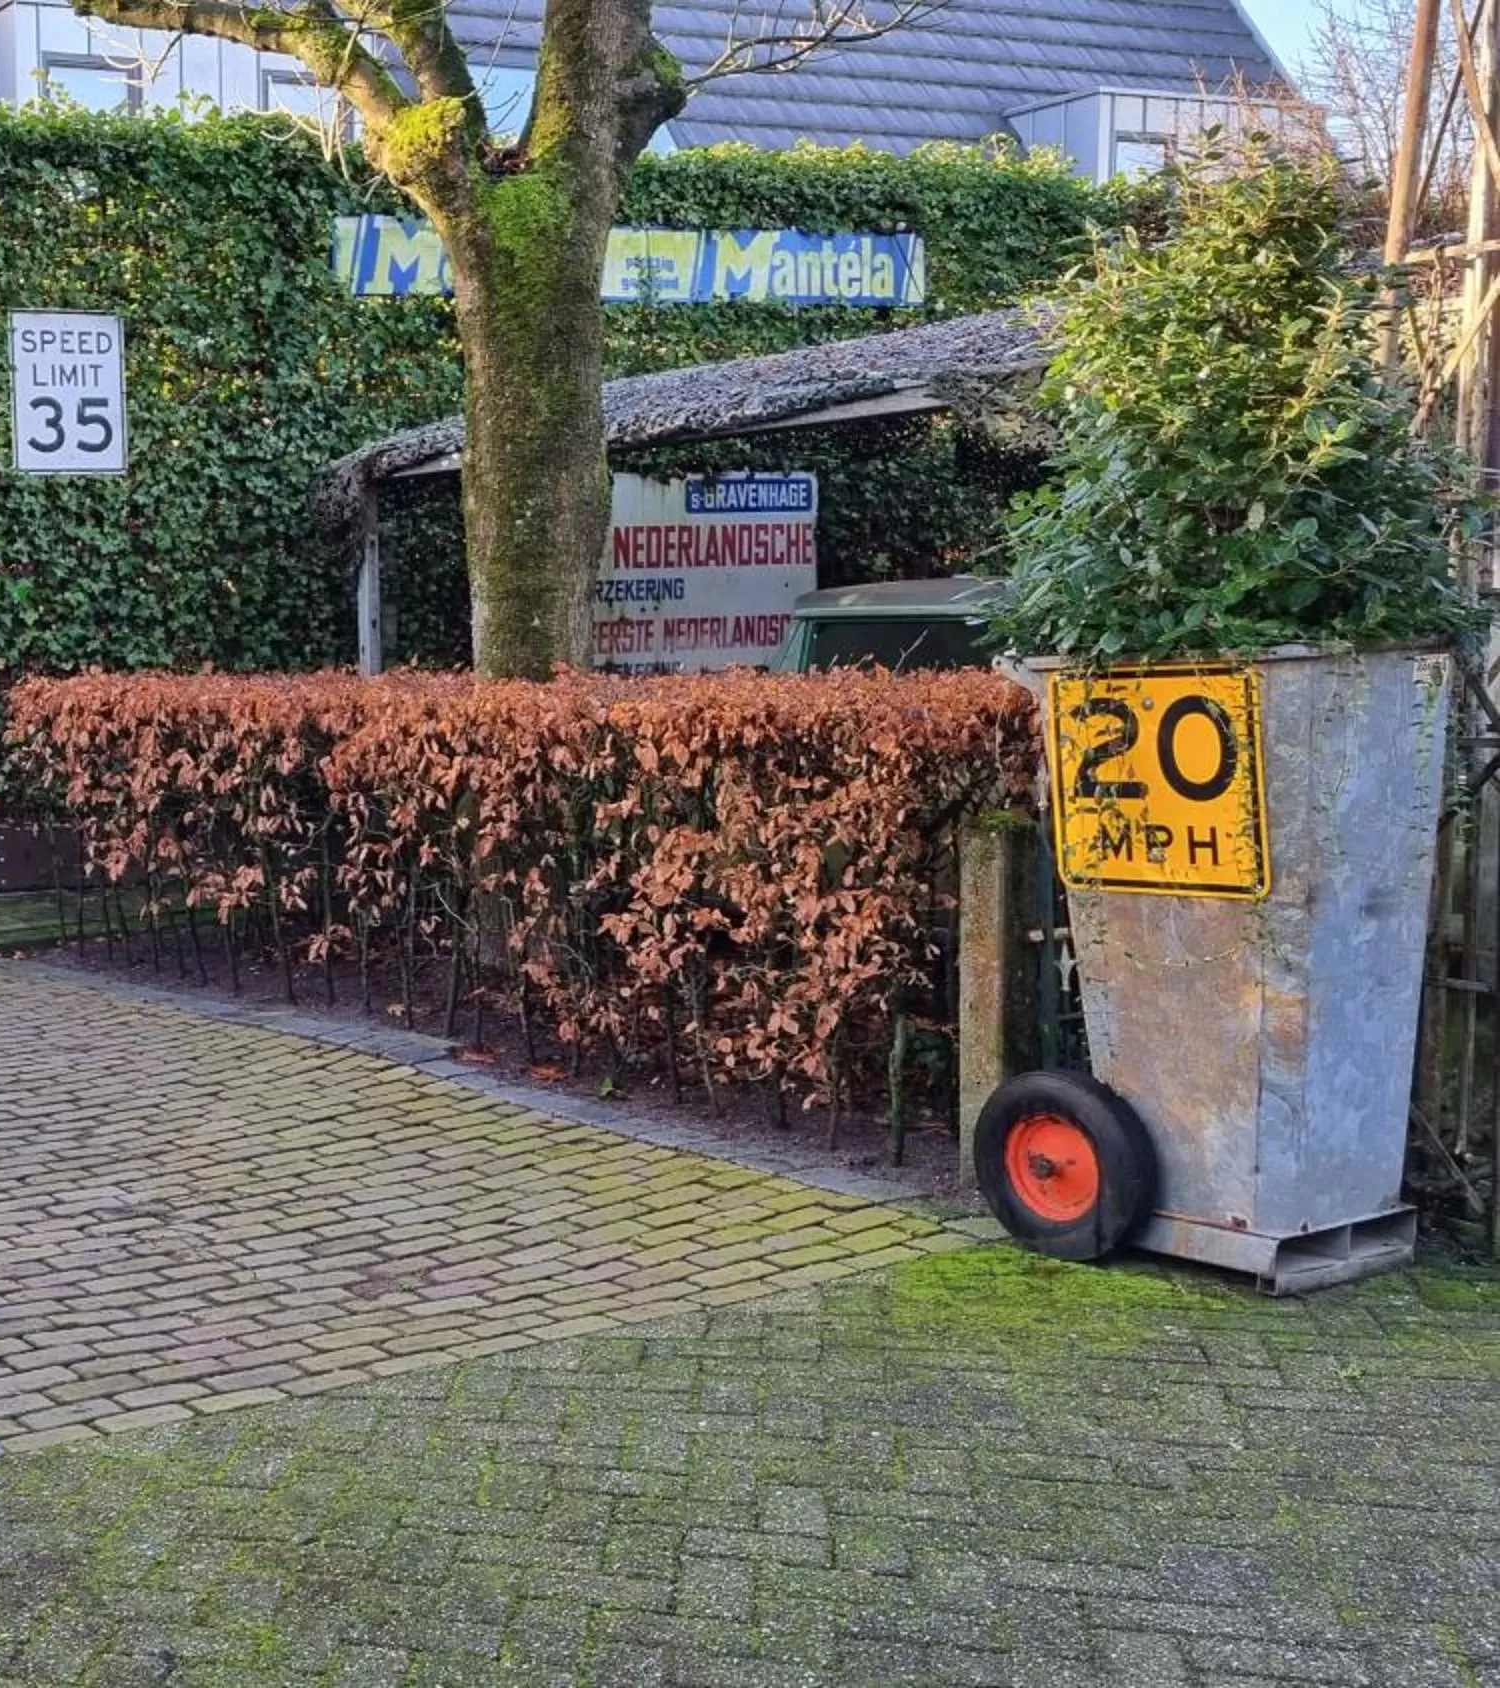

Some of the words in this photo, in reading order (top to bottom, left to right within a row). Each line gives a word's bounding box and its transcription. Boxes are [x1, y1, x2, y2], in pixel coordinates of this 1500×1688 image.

[711, 230, 894, 302] Mantéla
[21, 330, 112, 354] SPEED
[32, 364, 103, 387] LIMIT
[27, 396, 113, 453] 35
[613, 523, 813, 569] NEDERLANDSCHE
[1070, 694, 1239, 802] 20
[1099, 823, 1220, 866] MPH
